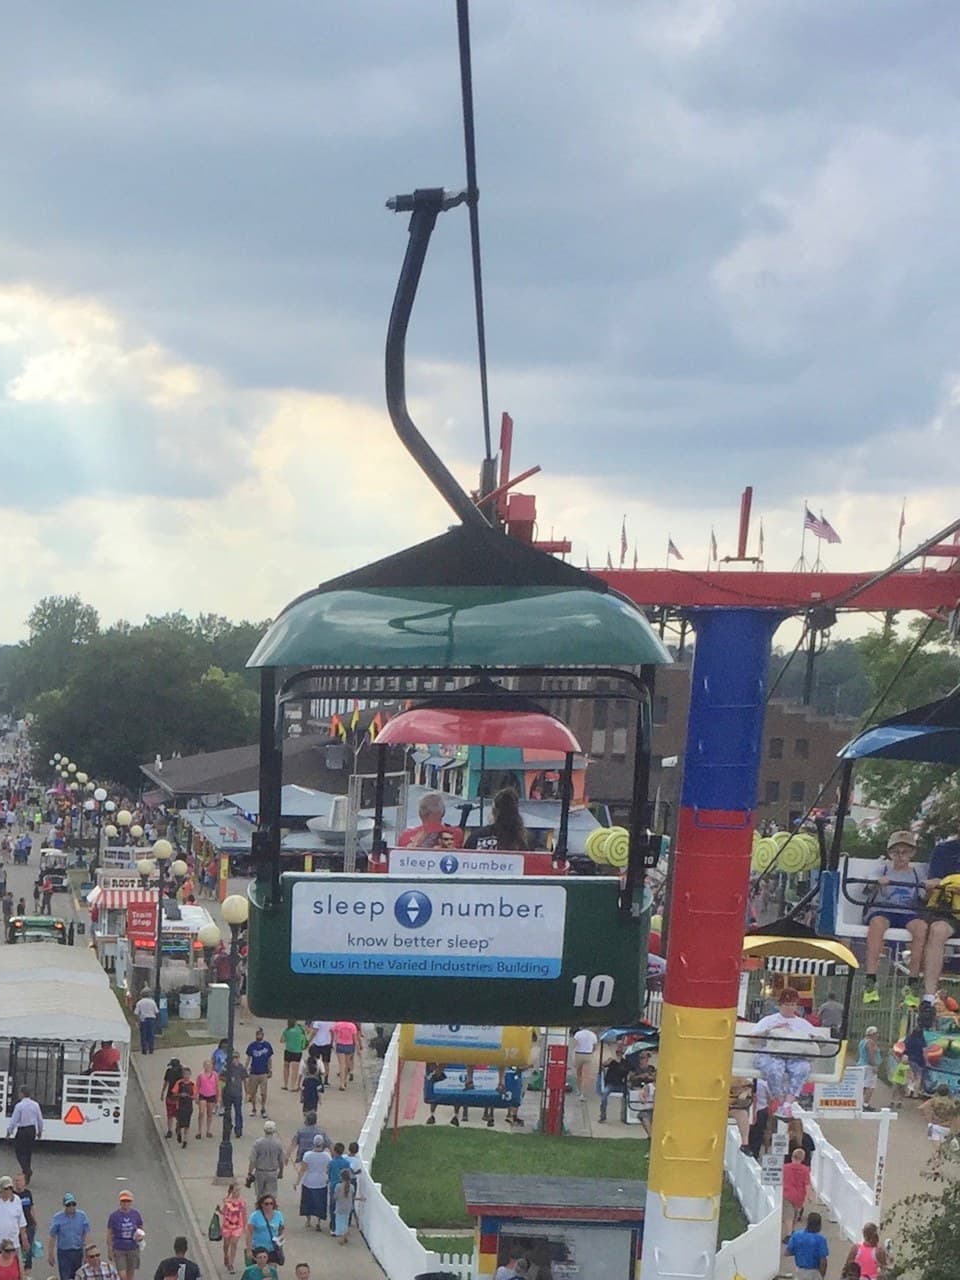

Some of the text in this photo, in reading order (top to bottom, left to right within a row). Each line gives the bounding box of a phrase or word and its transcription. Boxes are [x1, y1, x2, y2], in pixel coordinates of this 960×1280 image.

[400, 856, 436, 871] sleep
[313, 893, 385, 922] sleep
[132, 918, 152, 927] Stop
[347, 932, 389, 948] know
[393, 933, 442, 949] better
[300, 957, 549, 976] Visit us in the Varied Industries Building
[571, 974, 615, 1007] 10
[102, 1107, 111, 1118] 3
[874, 1156, 885, 1207] ENTRANCE
